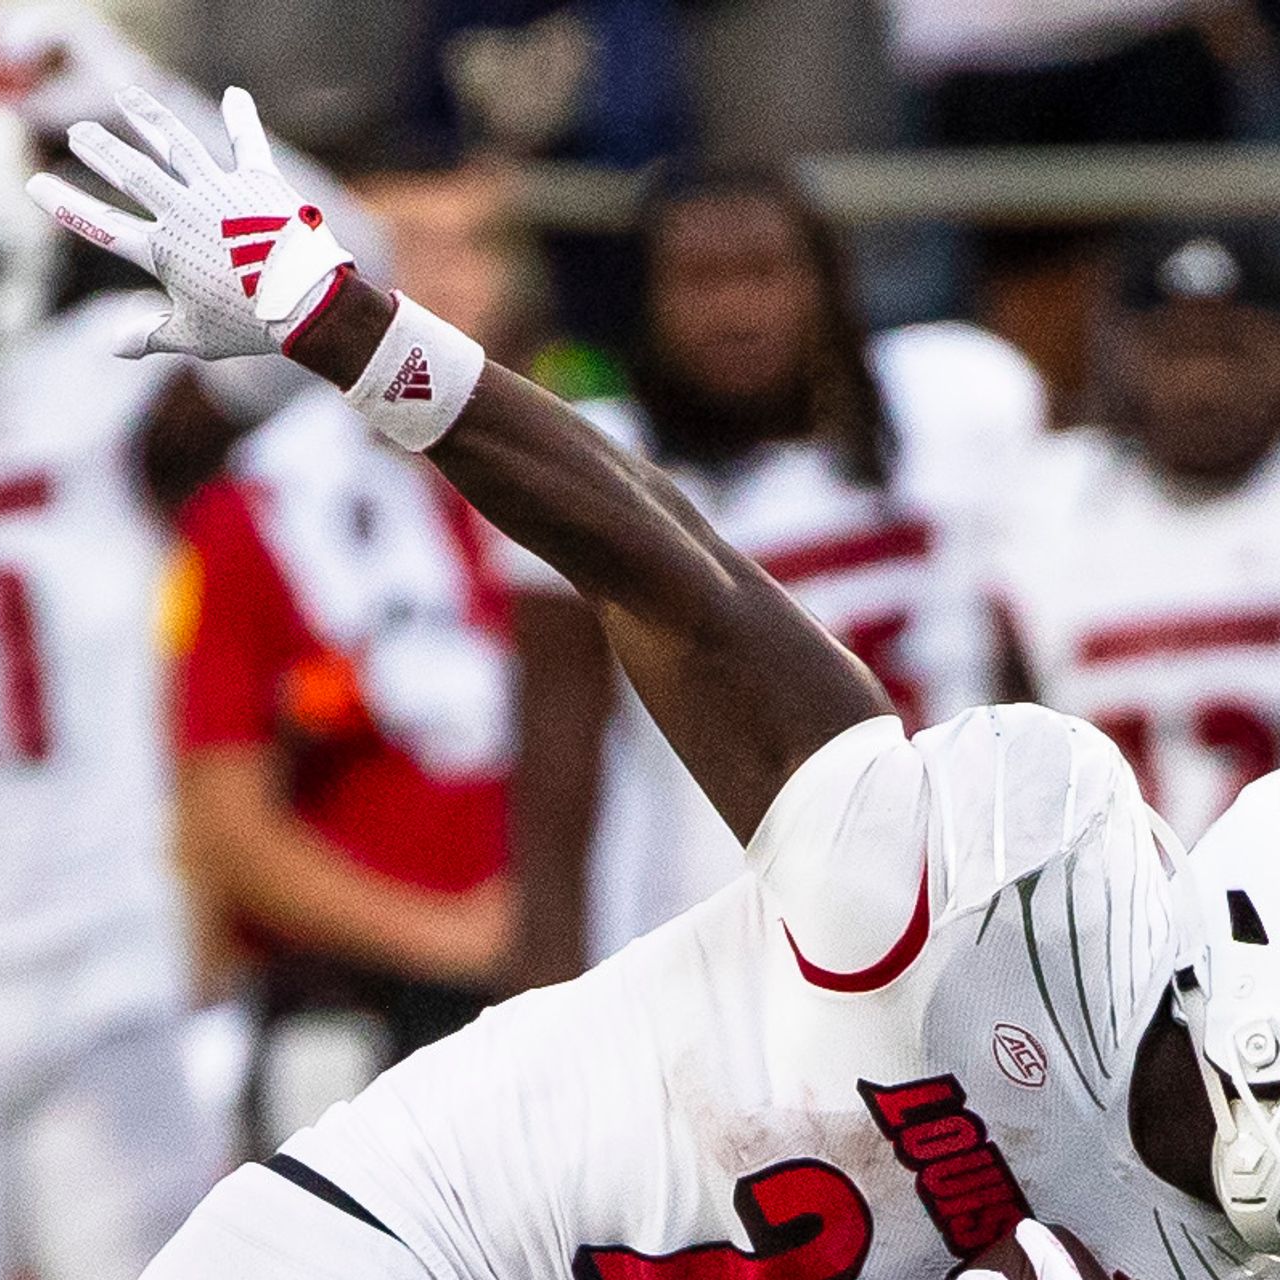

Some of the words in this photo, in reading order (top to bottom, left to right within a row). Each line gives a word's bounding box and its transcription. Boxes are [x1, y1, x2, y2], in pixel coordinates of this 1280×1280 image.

[55, 206, 115, 246] ADIZERO
[383, 347, 423, 403] adidas
[1001, 1035, 1044, 1078] ACC
[856, 1073, 1036, 1260] LOUIS
